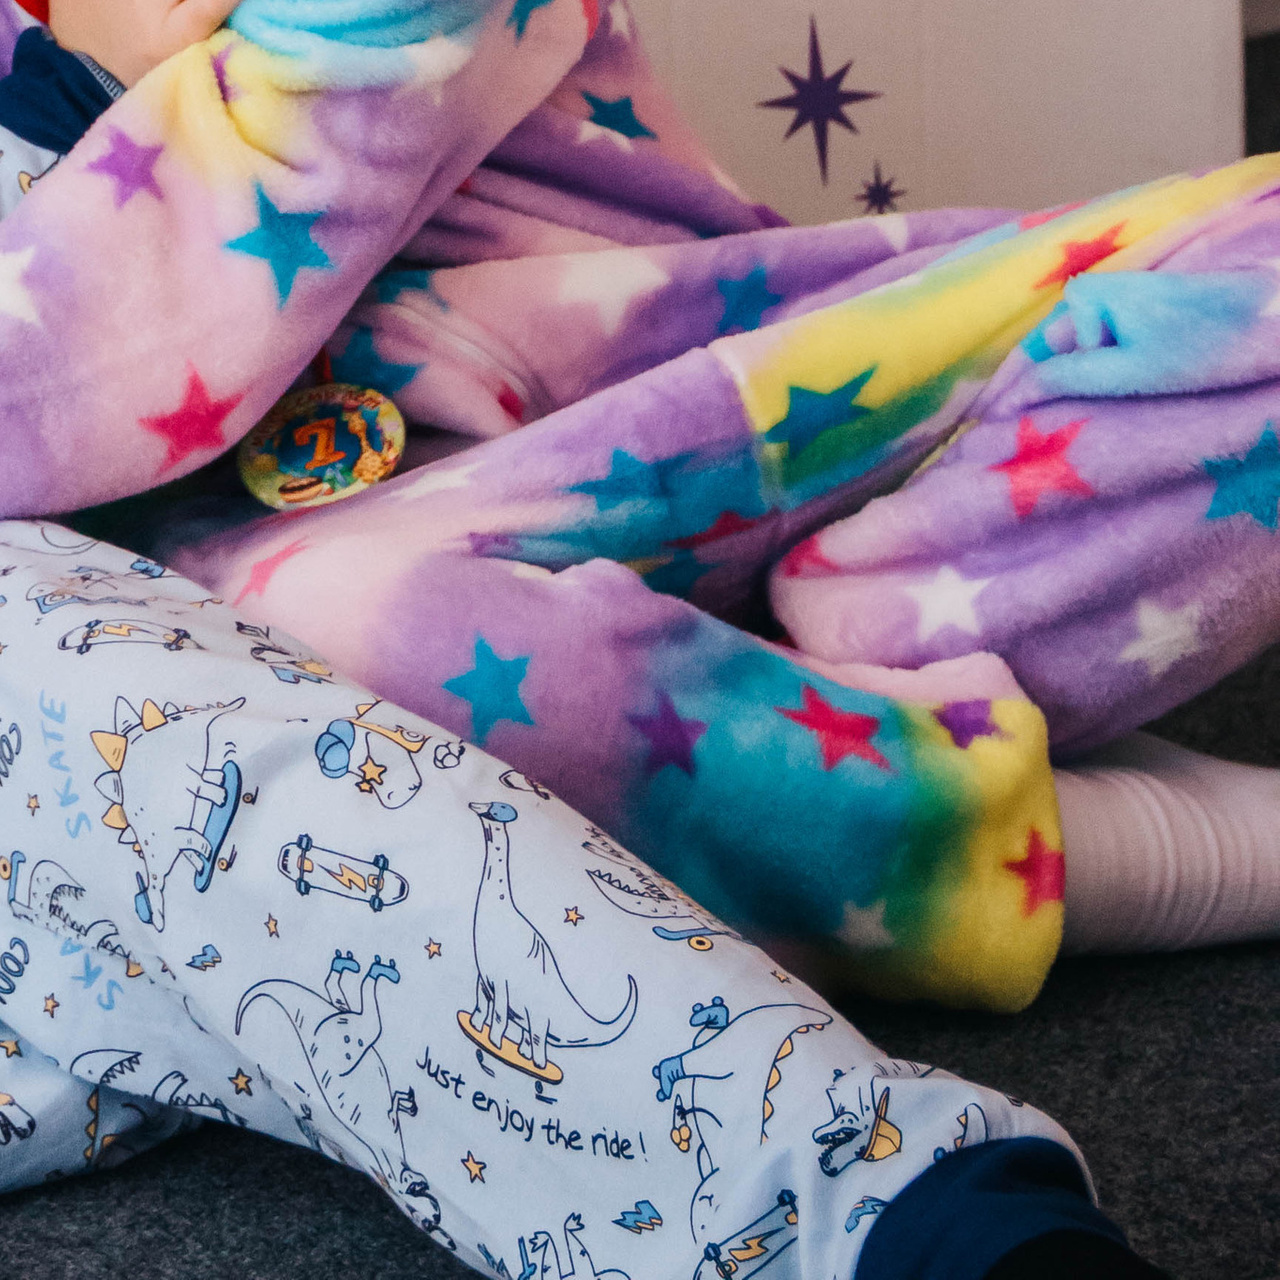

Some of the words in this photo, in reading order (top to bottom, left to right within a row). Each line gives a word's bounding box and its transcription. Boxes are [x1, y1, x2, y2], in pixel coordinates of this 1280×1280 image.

[38, 689, 92, 839] SKATE
[55, 930, 125, 1012] SKA
[415, 1045, 467, 1099] Just
[471, 1090, 535, 1143] enjoy
[540, 1117, 585, 1151] the
